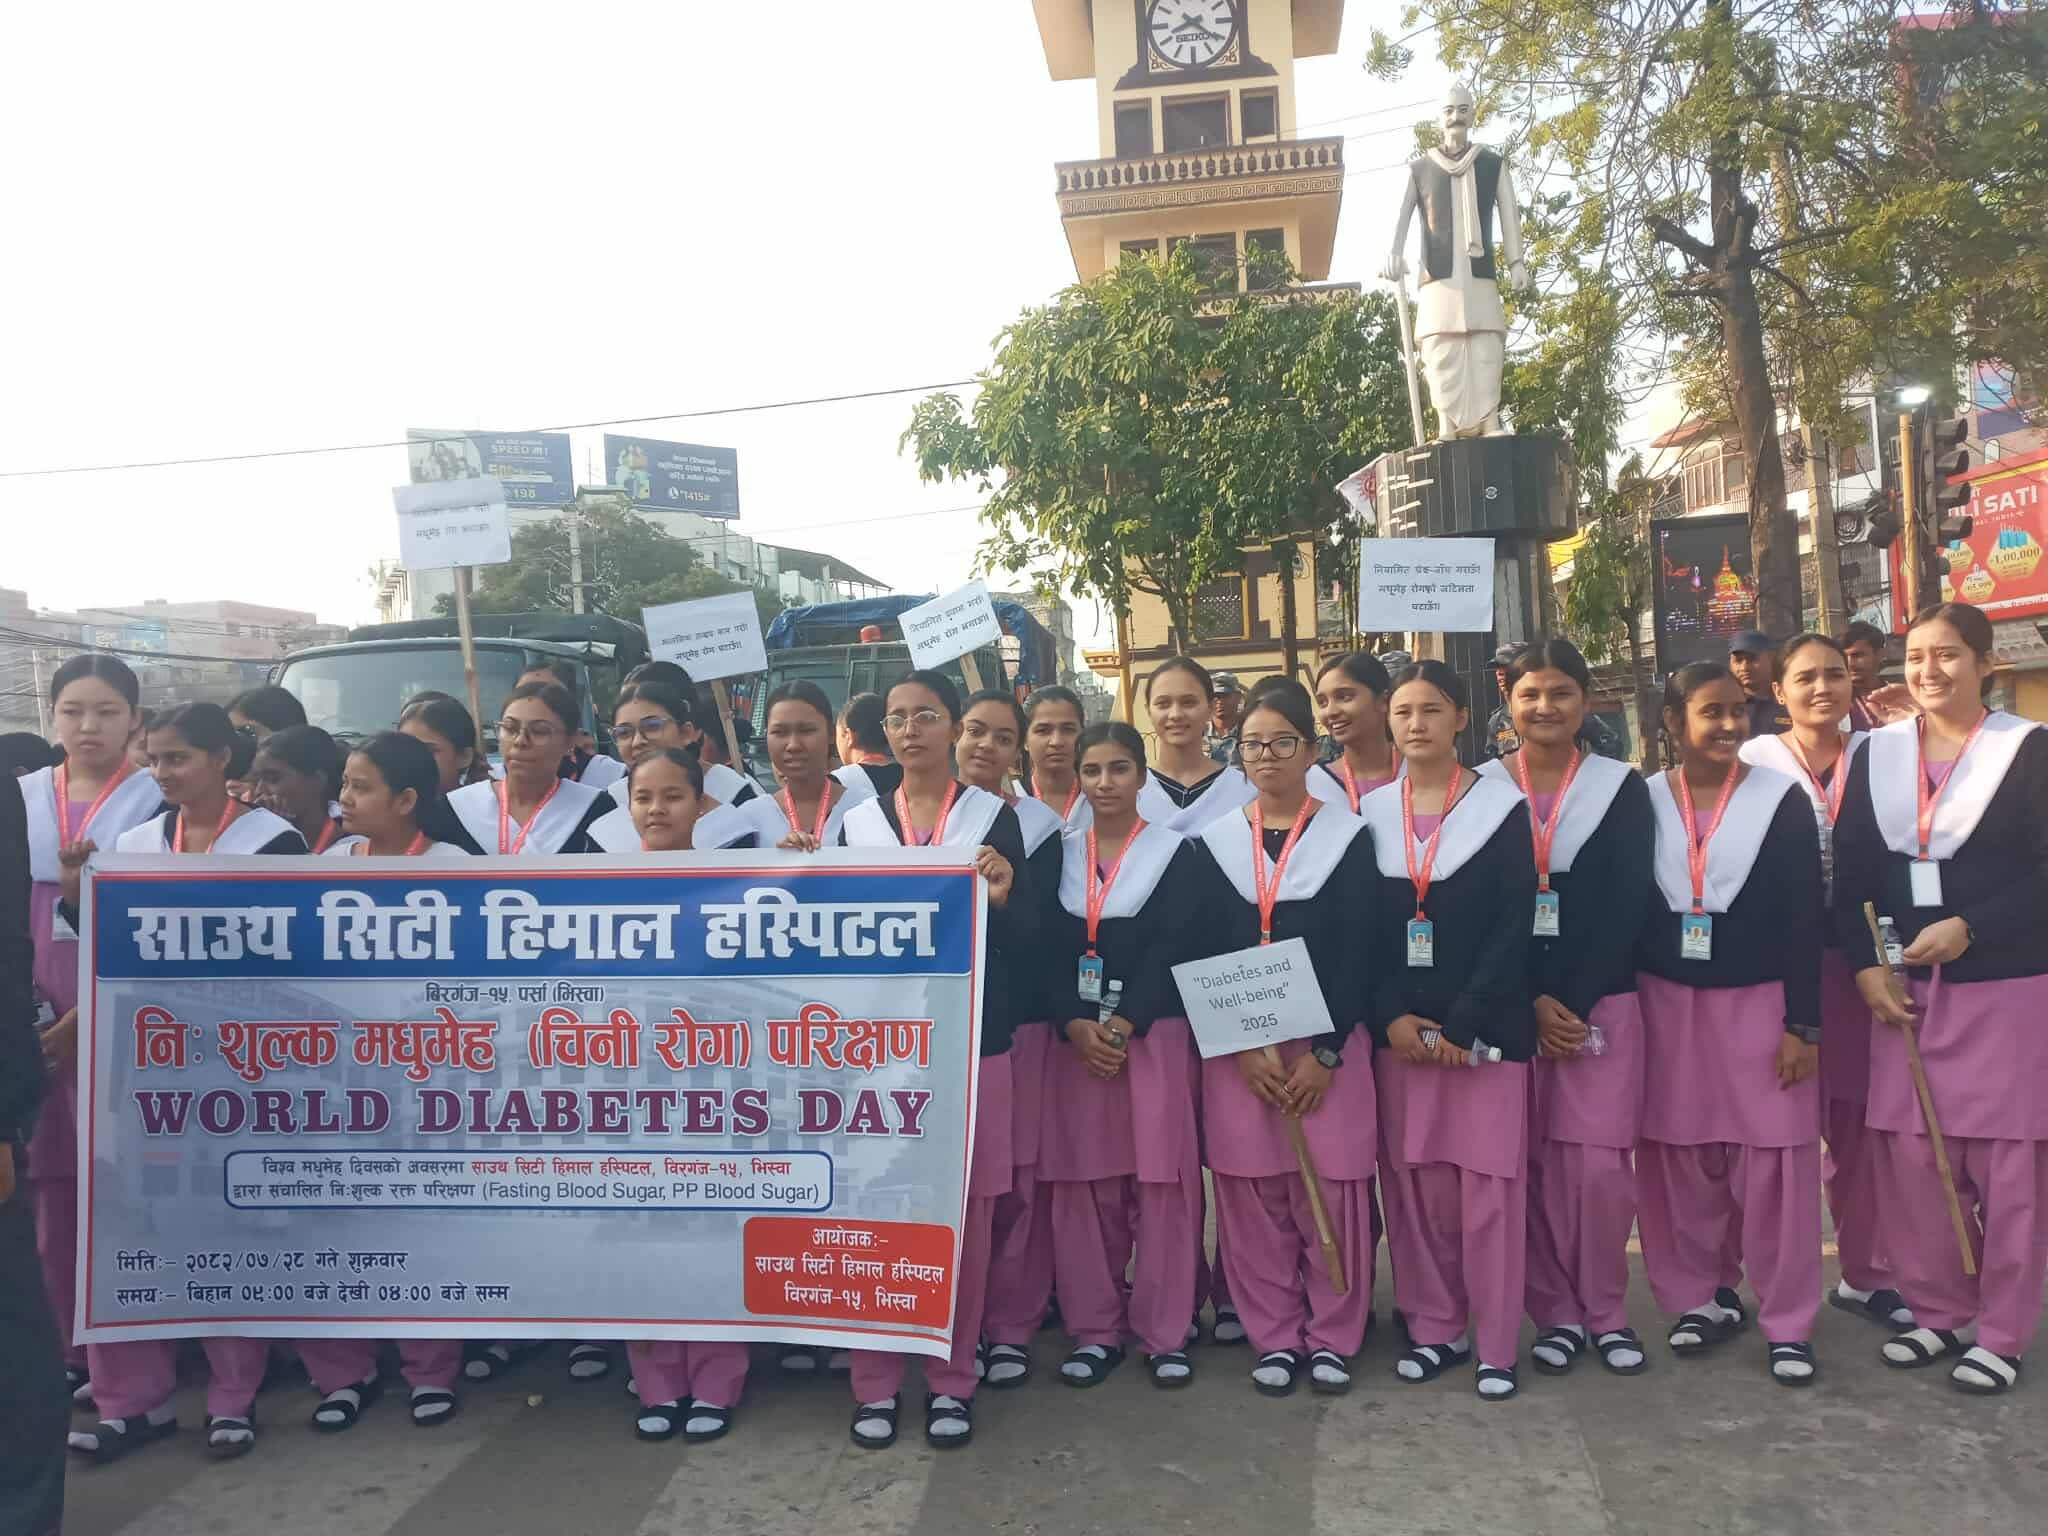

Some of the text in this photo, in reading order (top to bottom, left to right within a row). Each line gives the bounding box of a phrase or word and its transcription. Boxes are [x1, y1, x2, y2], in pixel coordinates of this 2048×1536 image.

[1984, 485, 2038, 513] SATI
[128, 887, 940, 961] साउथ सिटी हिमाल हस्पिटल
[1193, 959, 1293, 990] "Diabetes and
[1240, 1013, 1279, 1032] 2025
[217, 1020, 340, 1083] शुल्क
[351, 1007, 497, 1082] मधुमेह
[528, 1006, 641, 1069] (चिनी
[653, 1007, 751, 1071] रोग)
[766, 1002, 934, 1073] परिक्षण
[133, 1088, 933, 1138] WORLD DIABETES DAY
[301, 1157, 343, 1179] मधुमेह
[349, 1156, 402, 1176] दिवसको
[407, 1160, 465, 1176] अवसरमा
[471, 1160, 509, 1176] साउथ
[515, 1156, 546, 1176] सिटी
[552, 1156, 594, 1176] हिमाल
[232, 1184, 263, 1199] द्वारा
[389, 1184, 417, 1199] रक्त
[423, 1180, 476, 1199] परिक्षण
[482, 1181, 550, 1202] (Fasting
[557, 1181, 607, 1199] Blood
[612, 1182, 666, 1203] Sugar,
[672, 1183, 699, 1199] PP
[704, 1183, 755, 1200] Blood
[761, 1182, 820, 1204] Sugar)
[315, 1248, 339, 1269] गते
[347, 1252, 409, 1274] शुक्रवार
[754, 1254, 796, 1275] साउथ
[801, 1251, 835, 1277] सिटी
[841, 1252, 885, 1280] हिमाल
[336, 1280, 371, 1304] देखी
[474, 1285, 510, 1304] सम्म
